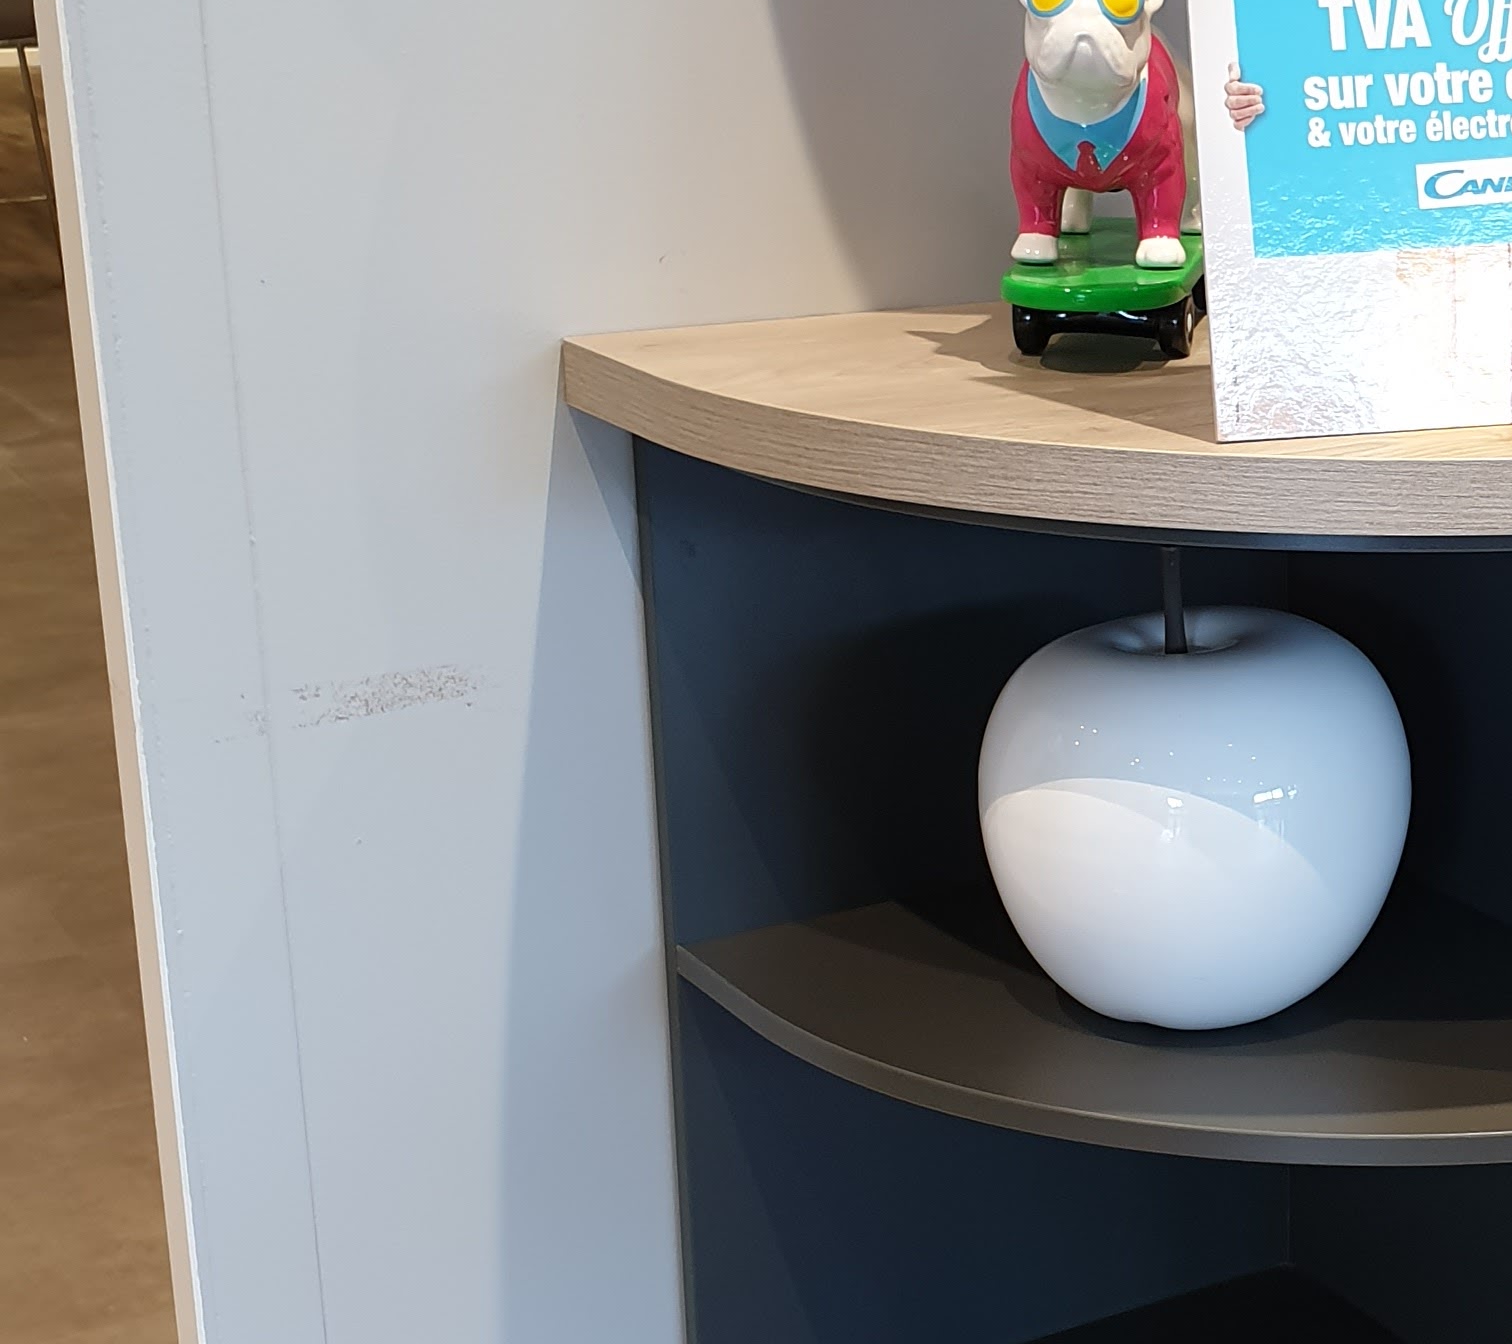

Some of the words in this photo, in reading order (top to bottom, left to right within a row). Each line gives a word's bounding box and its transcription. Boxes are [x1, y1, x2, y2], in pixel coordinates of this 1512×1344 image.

[1302, 72, 1374, 111] sur
[1384, 61, 1494, 107] votre
[1306, 116, 1332, 148] &
[1337, 113, 1418, 146] votre
